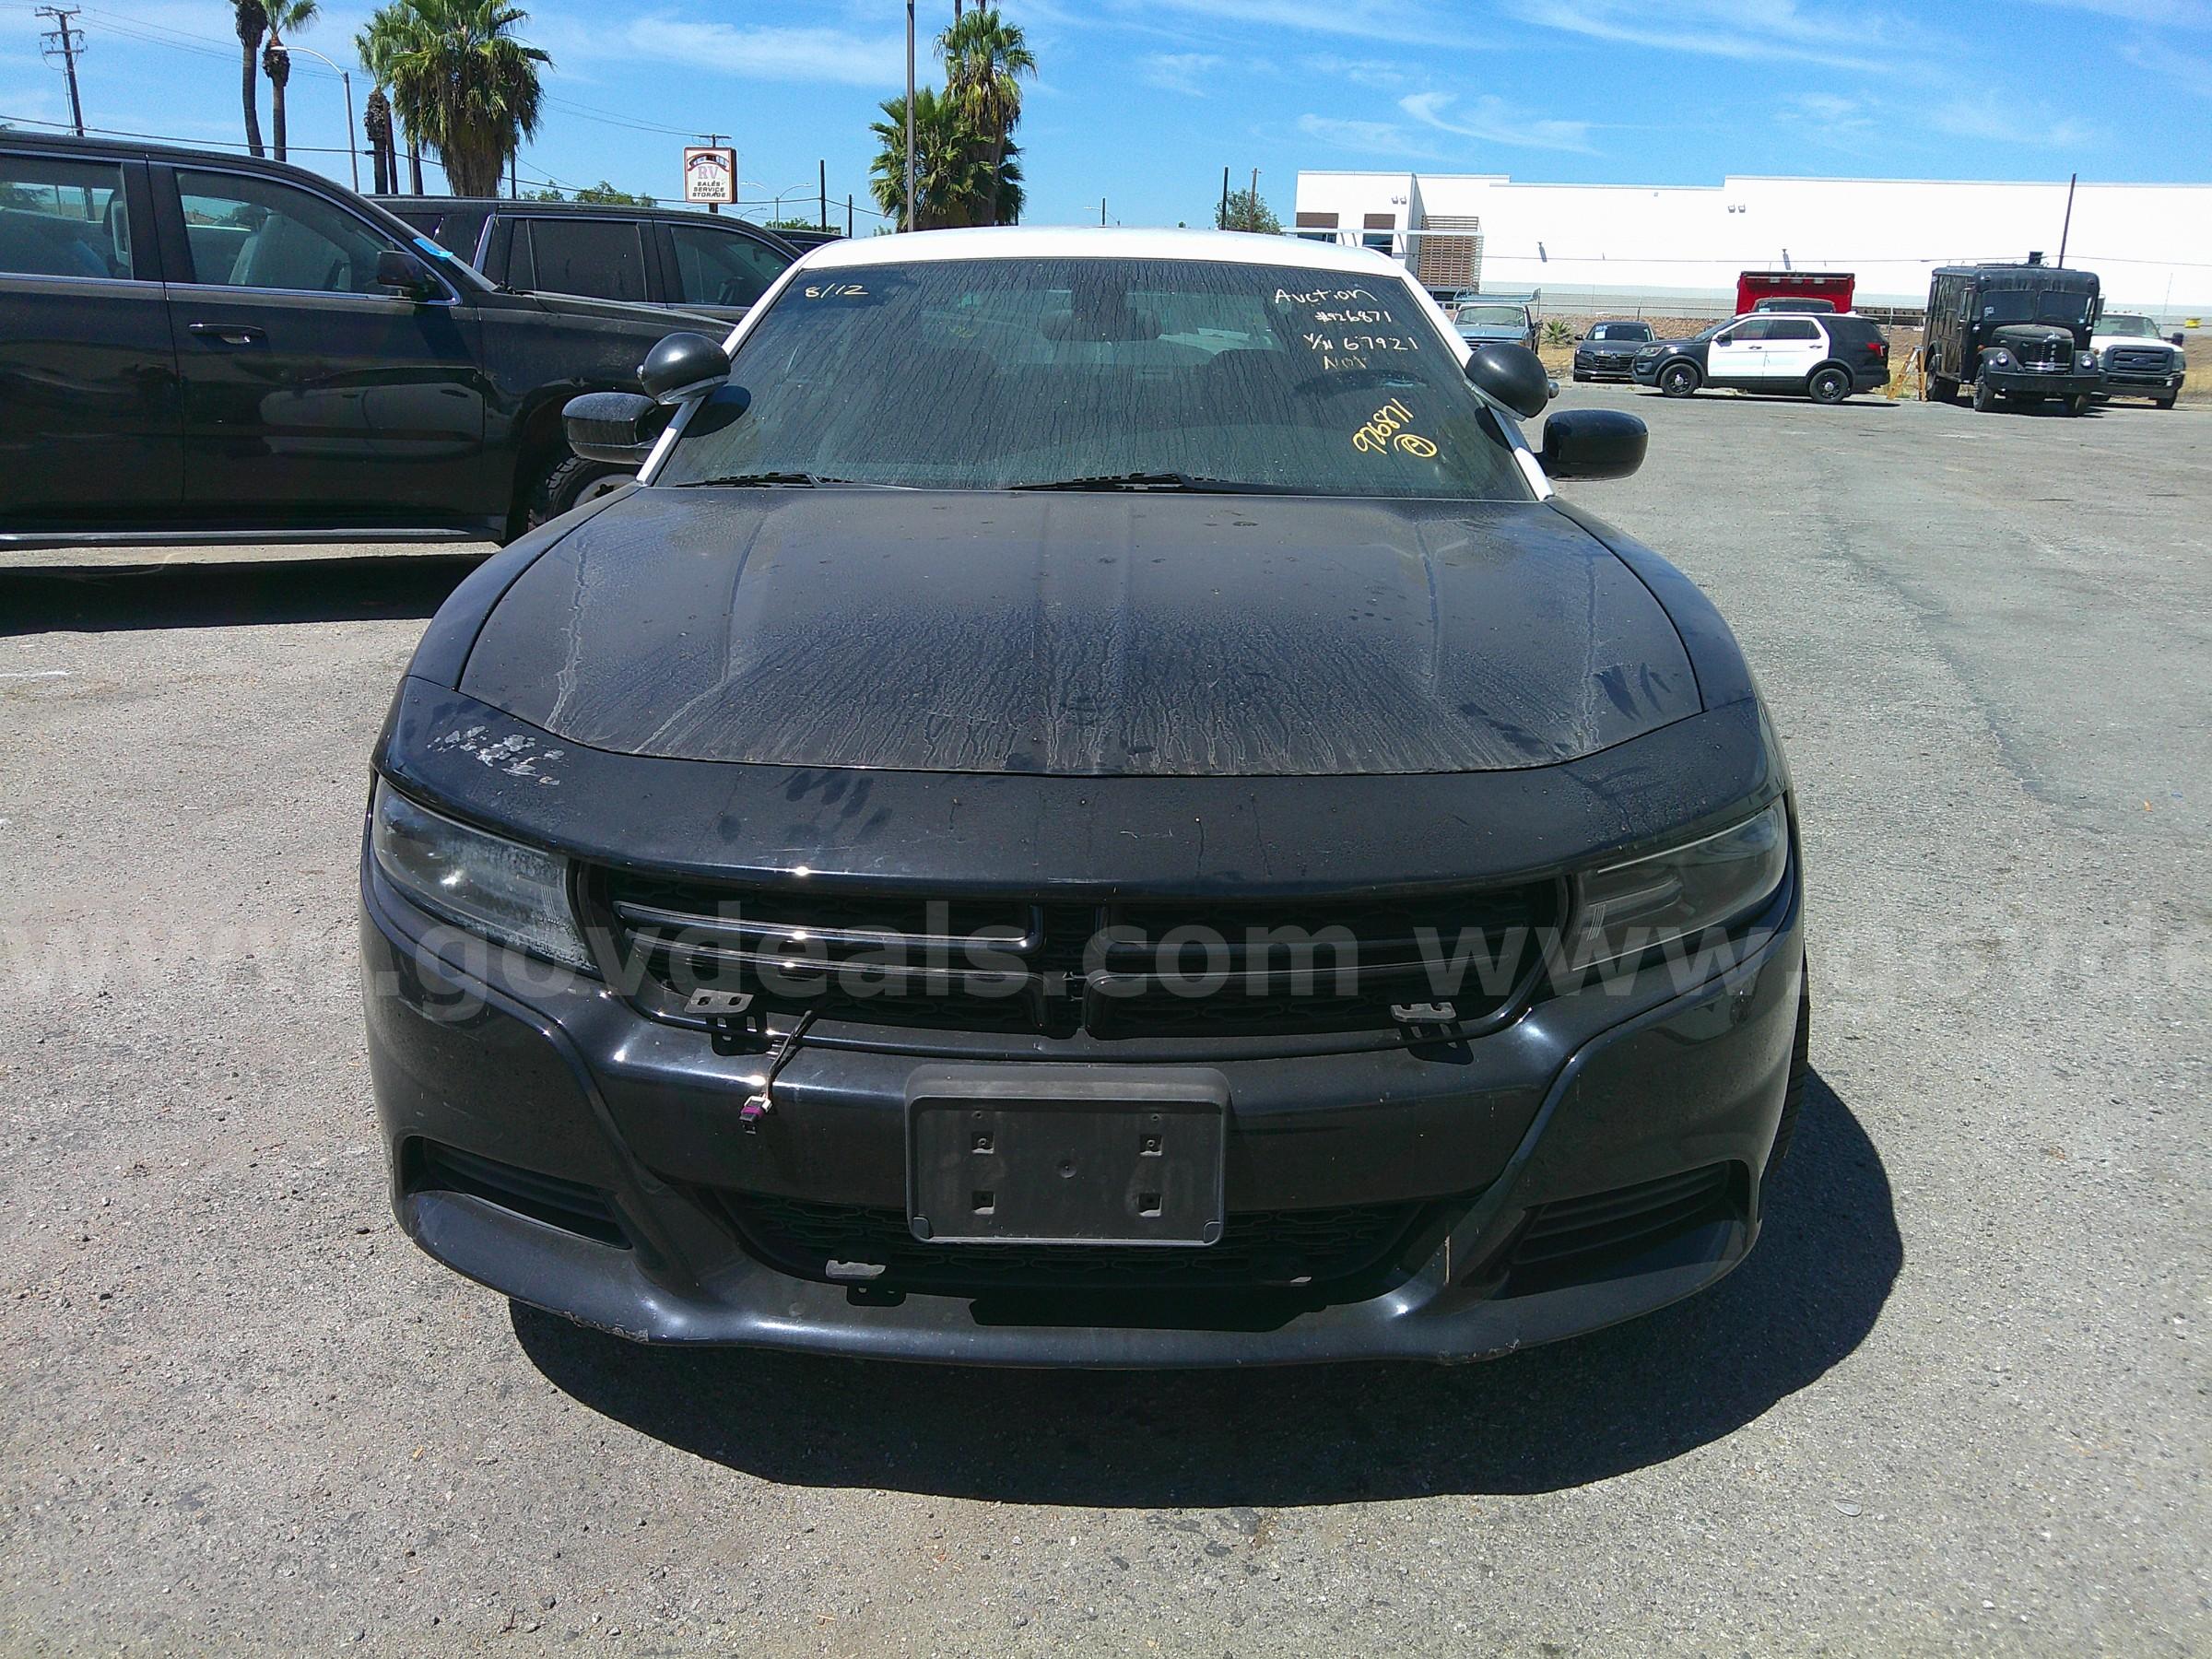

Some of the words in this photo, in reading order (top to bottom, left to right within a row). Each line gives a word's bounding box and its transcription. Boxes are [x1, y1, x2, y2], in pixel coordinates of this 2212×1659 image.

[698, 166, 719, 180] RV
[805, 283, 869, 299] 8/12
[1343, 335, 1418, 350] 67921
